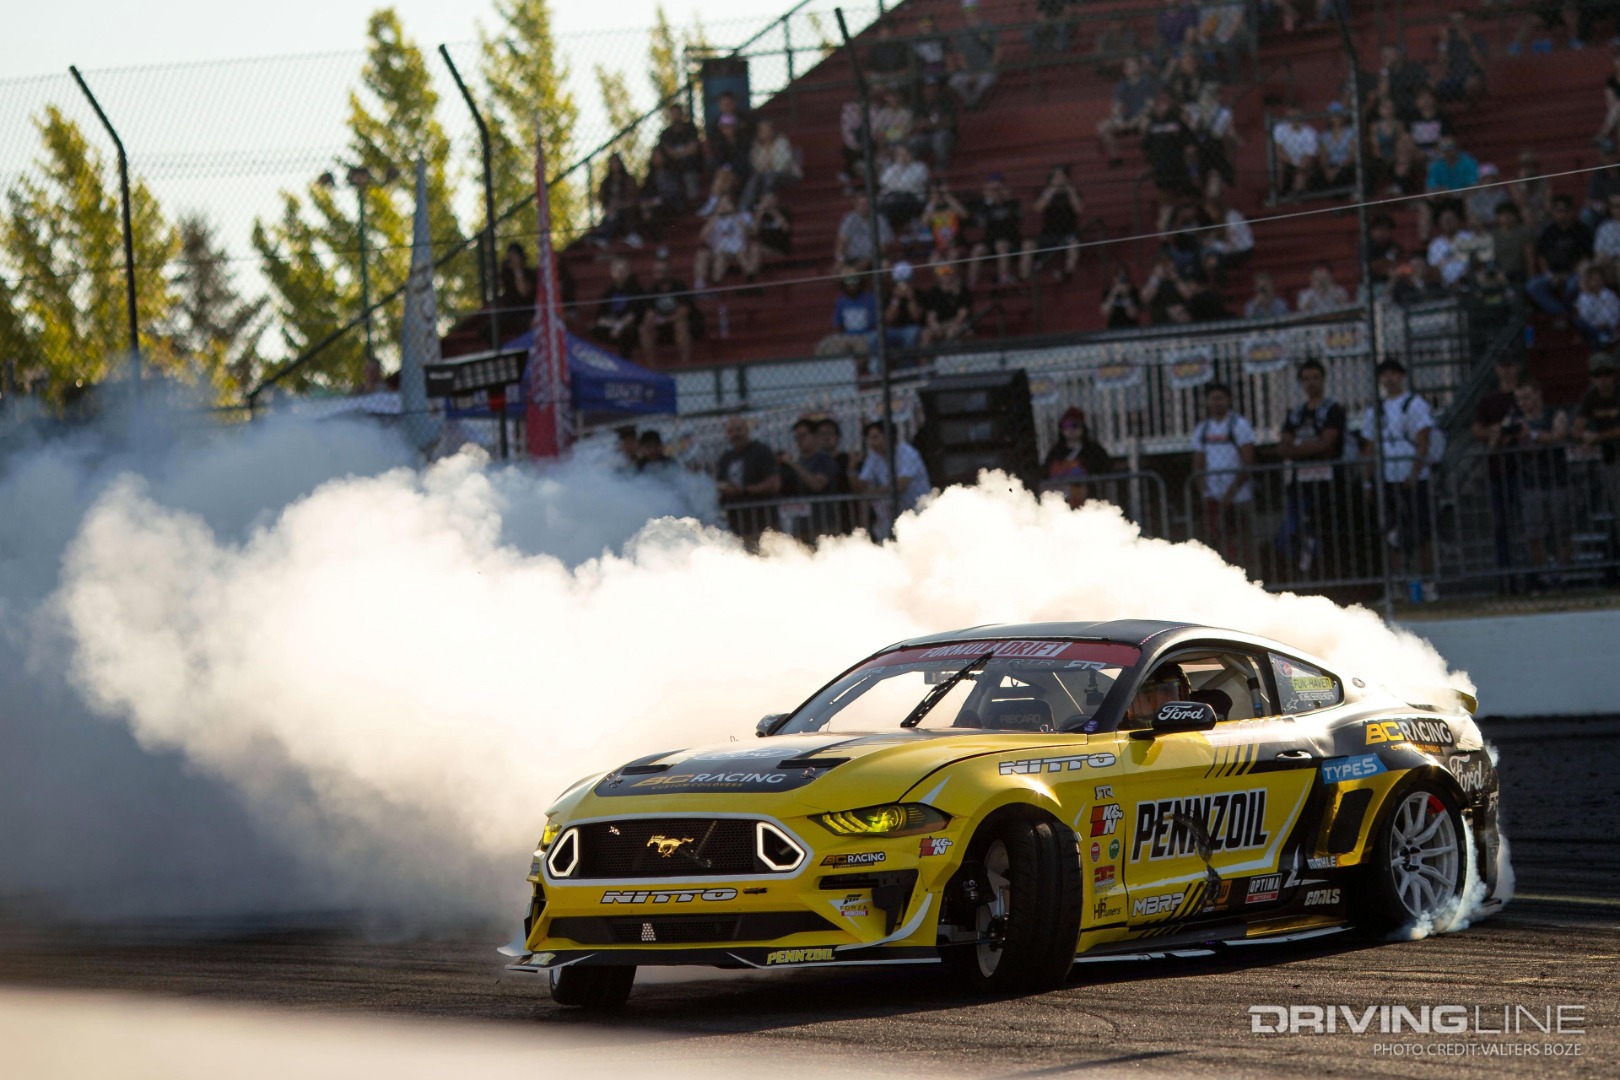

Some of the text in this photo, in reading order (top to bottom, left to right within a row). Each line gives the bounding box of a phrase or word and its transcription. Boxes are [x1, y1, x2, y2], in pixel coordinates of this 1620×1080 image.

[1158, 705, 1204, 721] Ford
[998, 752, 1116, 776] NITTO
[1449, 754, 1485, 793] Ford
[1129, 787, 1272, 864] PENNZOIL
[1249, 876, 1280, 893] OPTIMA
[600, 887, 738, 904] NITTO
[1131, 892, 1186, 917] MBRP
[766, 948, 836, 965] PENNZOIL
